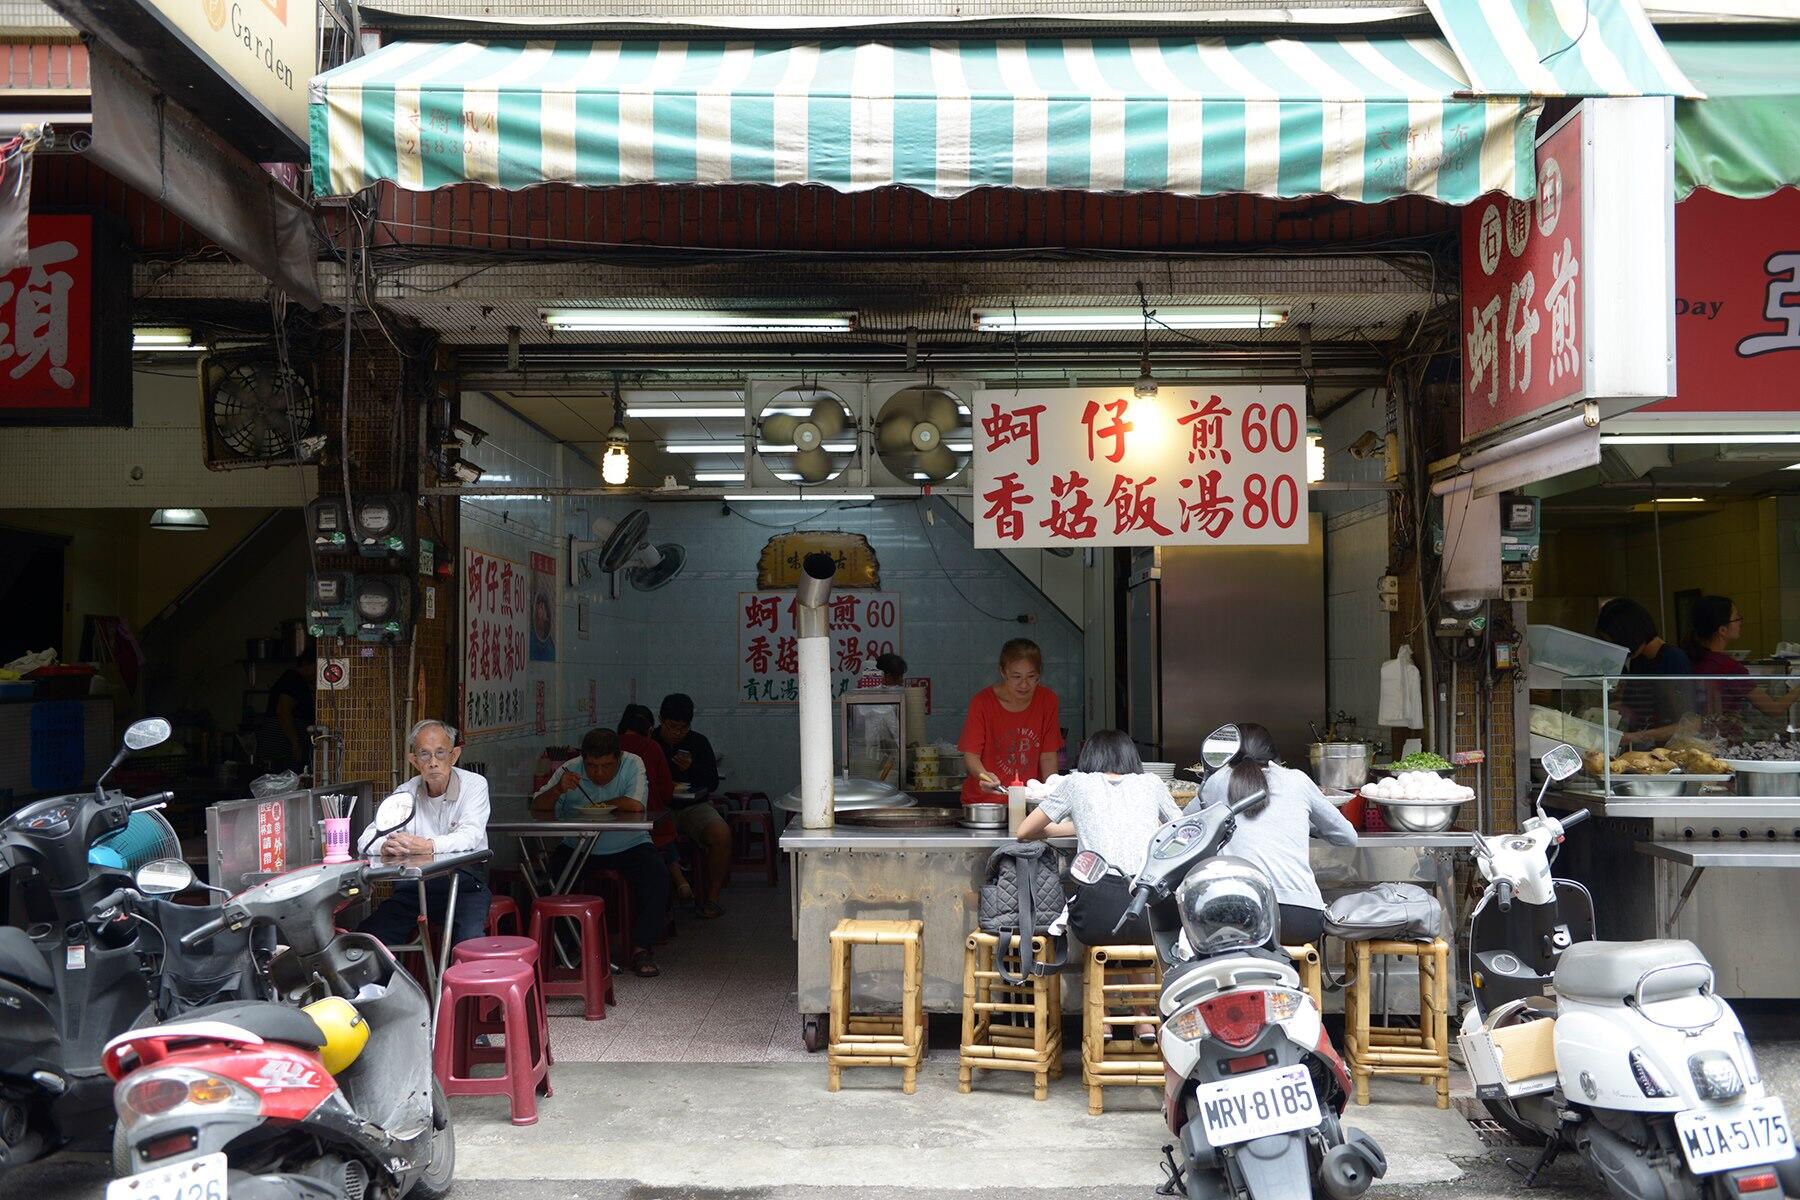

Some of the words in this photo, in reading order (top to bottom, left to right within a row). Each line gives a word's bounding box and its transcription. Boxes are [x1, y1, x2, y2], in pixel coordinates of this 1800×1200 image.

[231, 3, 293, 91] Garden
[1467, 237, 1581, 408] 蚵仔煎
